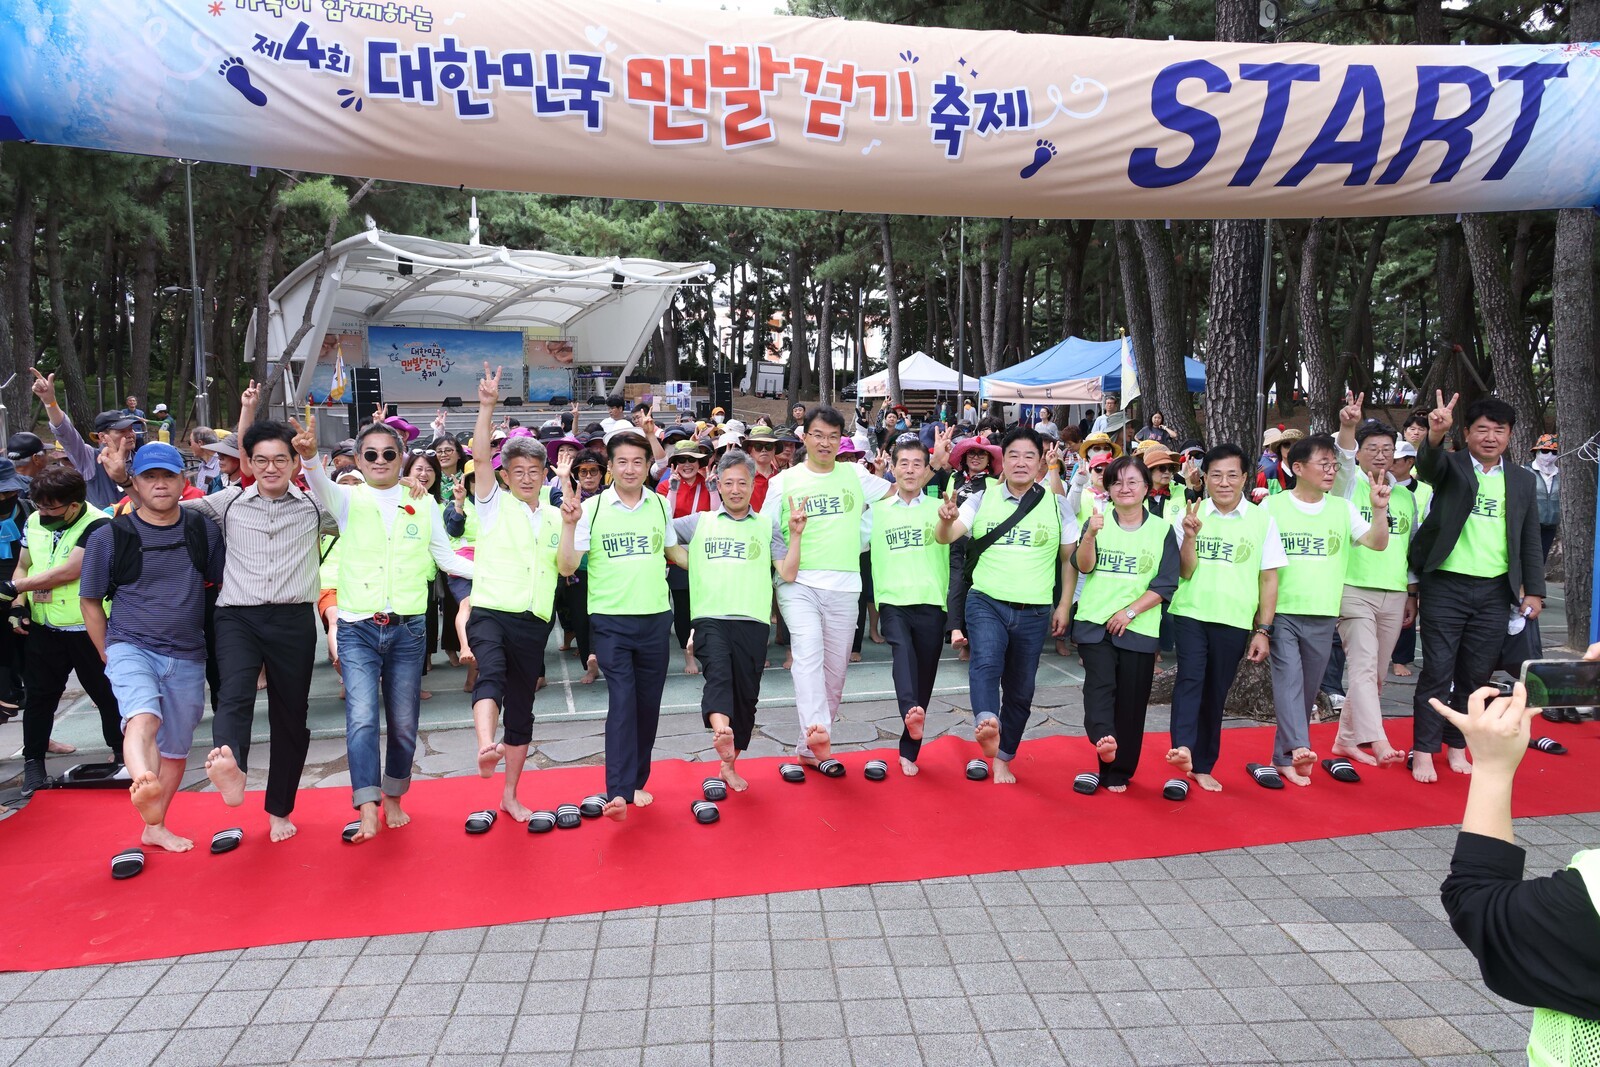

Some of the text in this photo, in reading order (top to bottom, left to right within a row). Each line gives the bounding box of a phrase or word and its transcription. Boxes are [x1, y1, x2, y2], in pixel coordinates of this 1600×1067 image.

[322, 0, 433, 32] 함께하는
[251, 20, 1029, 156] 제4회 대한민국 맨발걷기 축제
[1127, 59, 1569, 189] START
[411, 347, 441, 358] 대한민국
[401, 357, 442, 372] 맨발걷기
[421, 369, 437, 381] 축제
[602, 536, 651, 558] 맨발로
[705, 541, 746, 560] 맨발로
[886, 529, 924, 551] 맨발로
[1281, 537, 1327, 557] 맨발로
